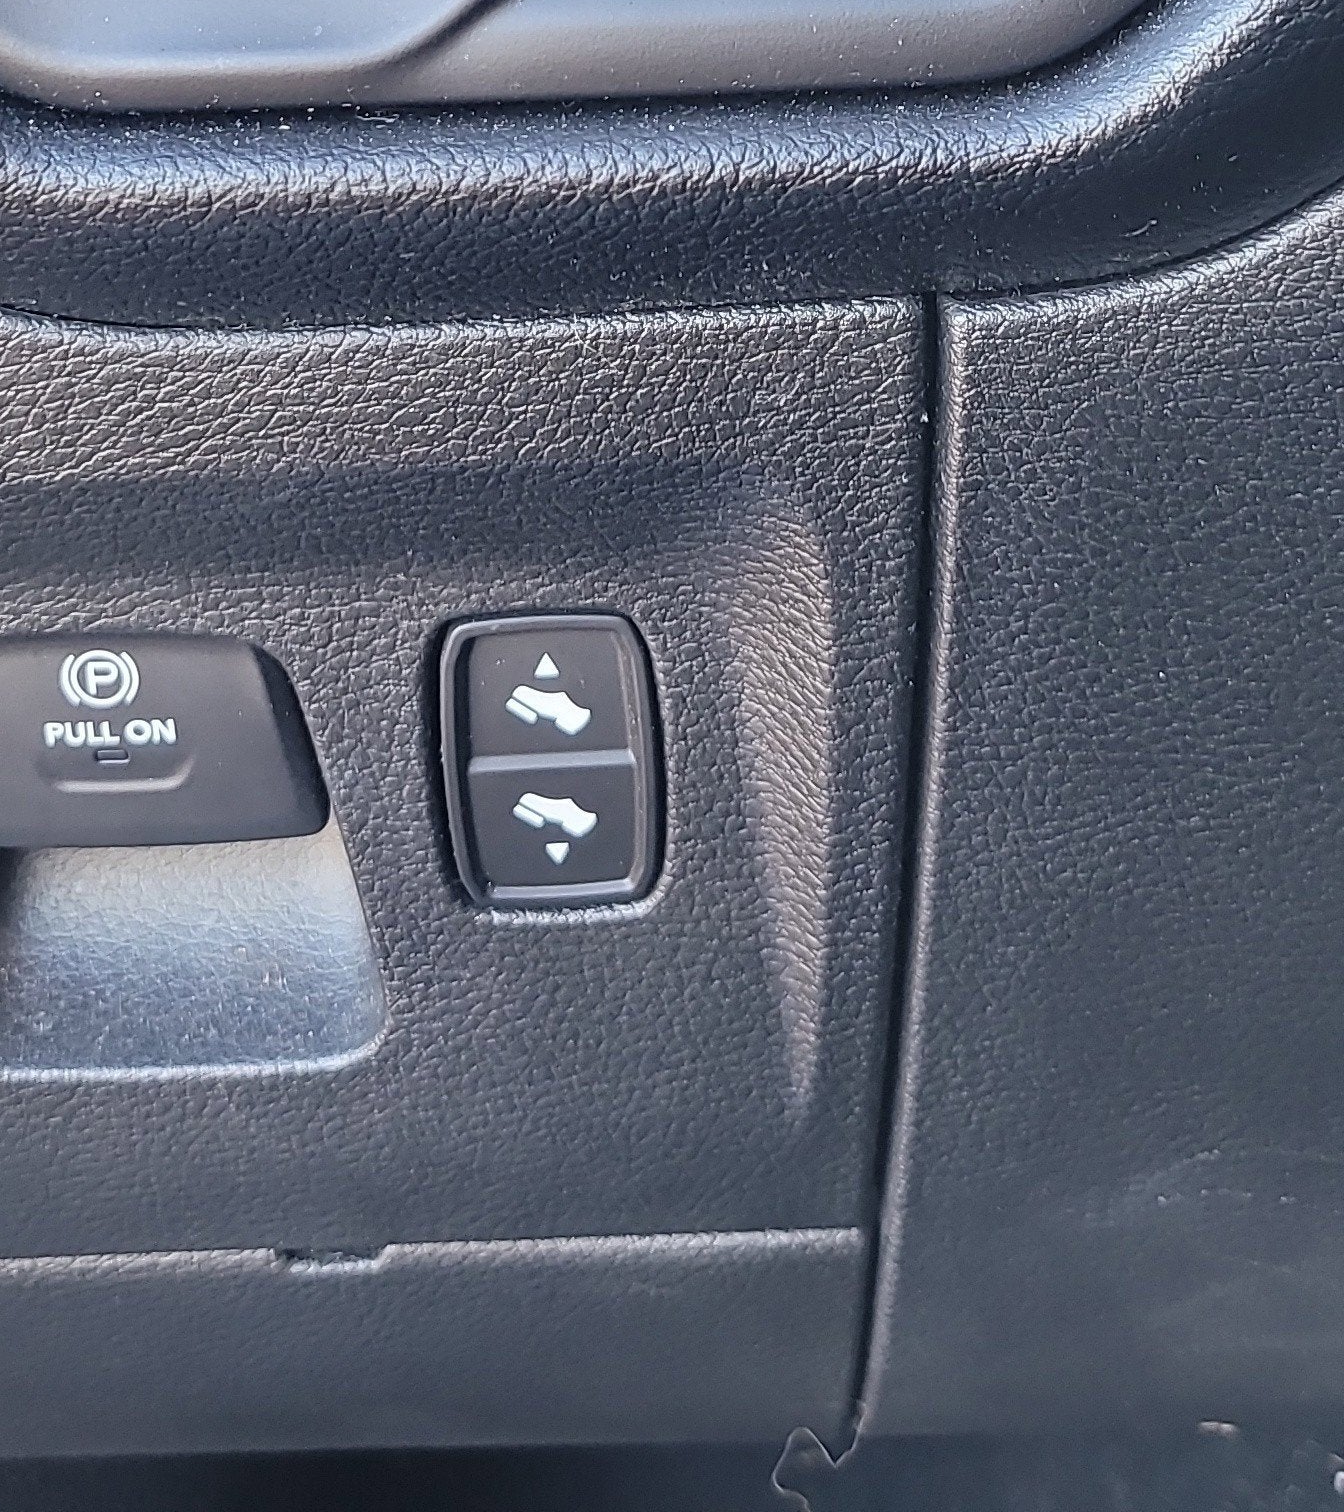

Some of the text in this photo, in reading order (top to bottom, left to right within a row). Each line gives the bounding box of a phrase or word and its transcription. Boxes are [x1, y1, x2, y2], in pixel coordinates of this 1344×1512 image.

[85, 660, 119, 696] P
[43, 718, 178, 748] PULL ON
